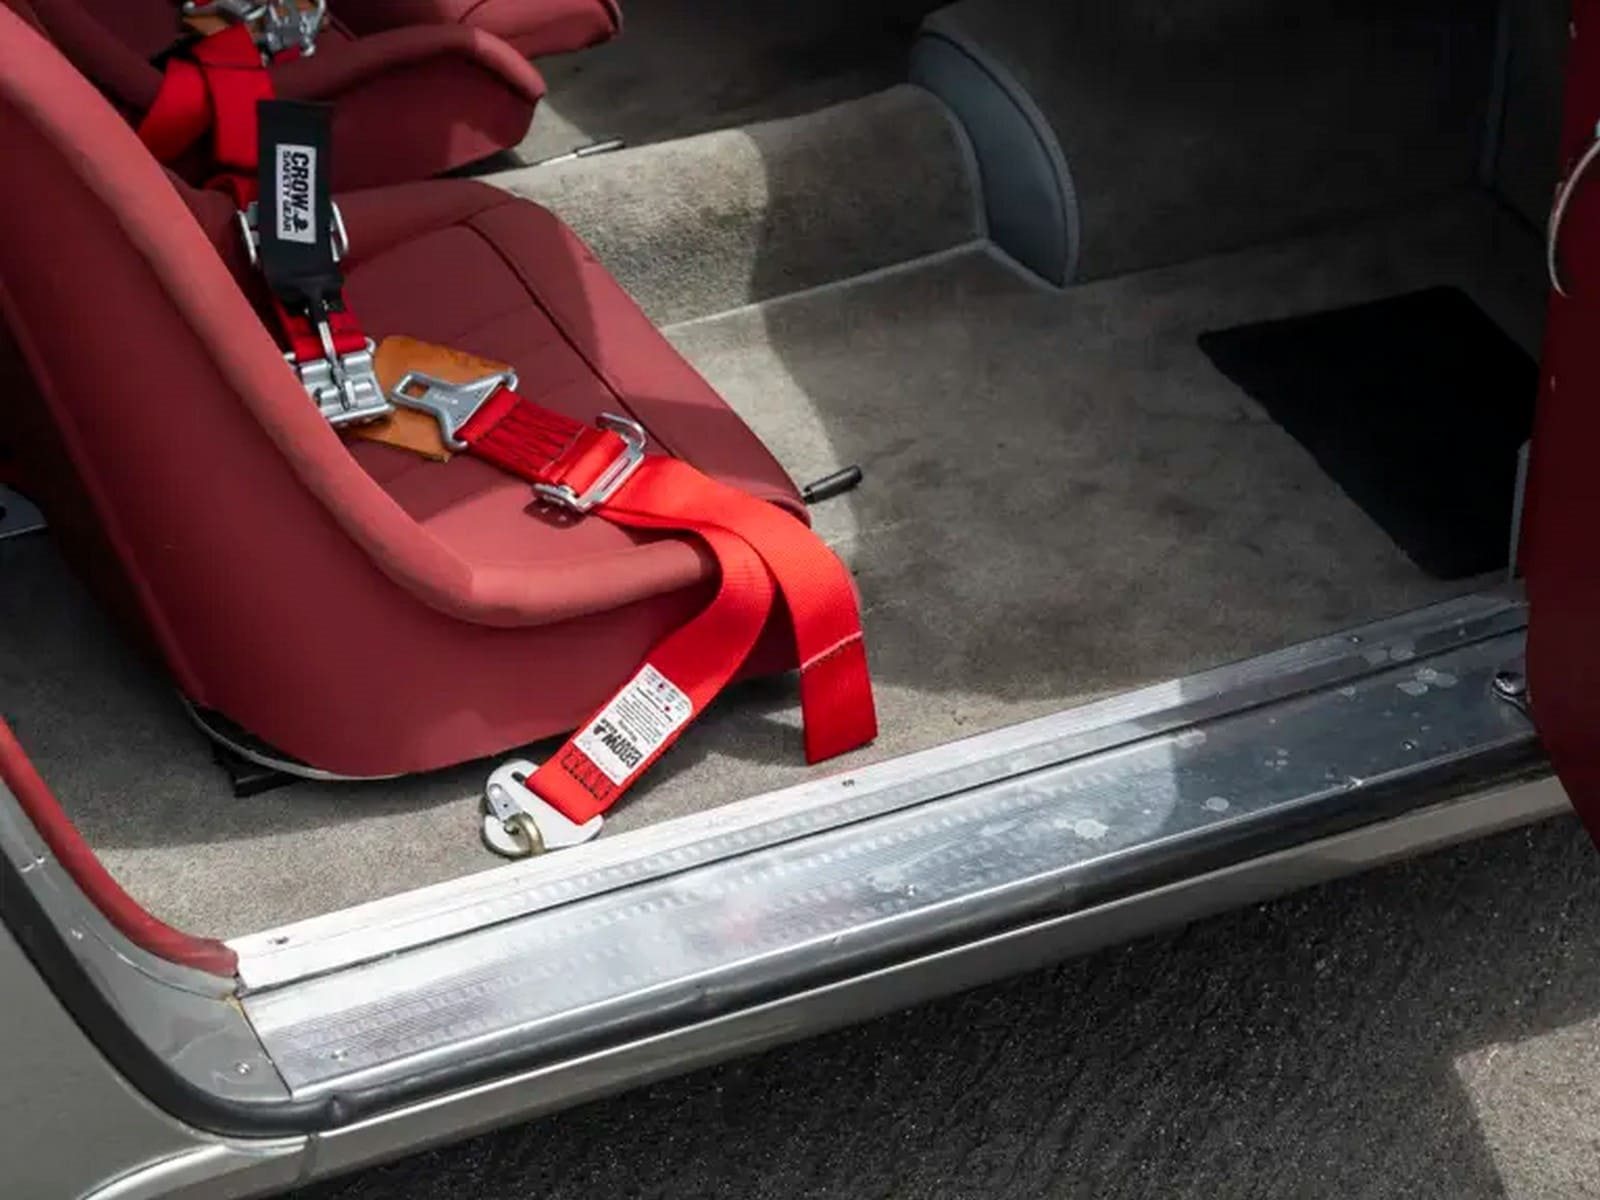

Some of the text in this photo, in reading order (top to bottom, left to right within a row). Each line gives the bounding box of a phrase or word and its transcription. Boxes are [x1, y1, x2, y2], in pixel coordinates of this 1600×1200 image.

[283, 151, 292, 231] SAFETY GEAR
[291, 151, 309, 212] CROW
[600, 732, 639, 769] CROW
